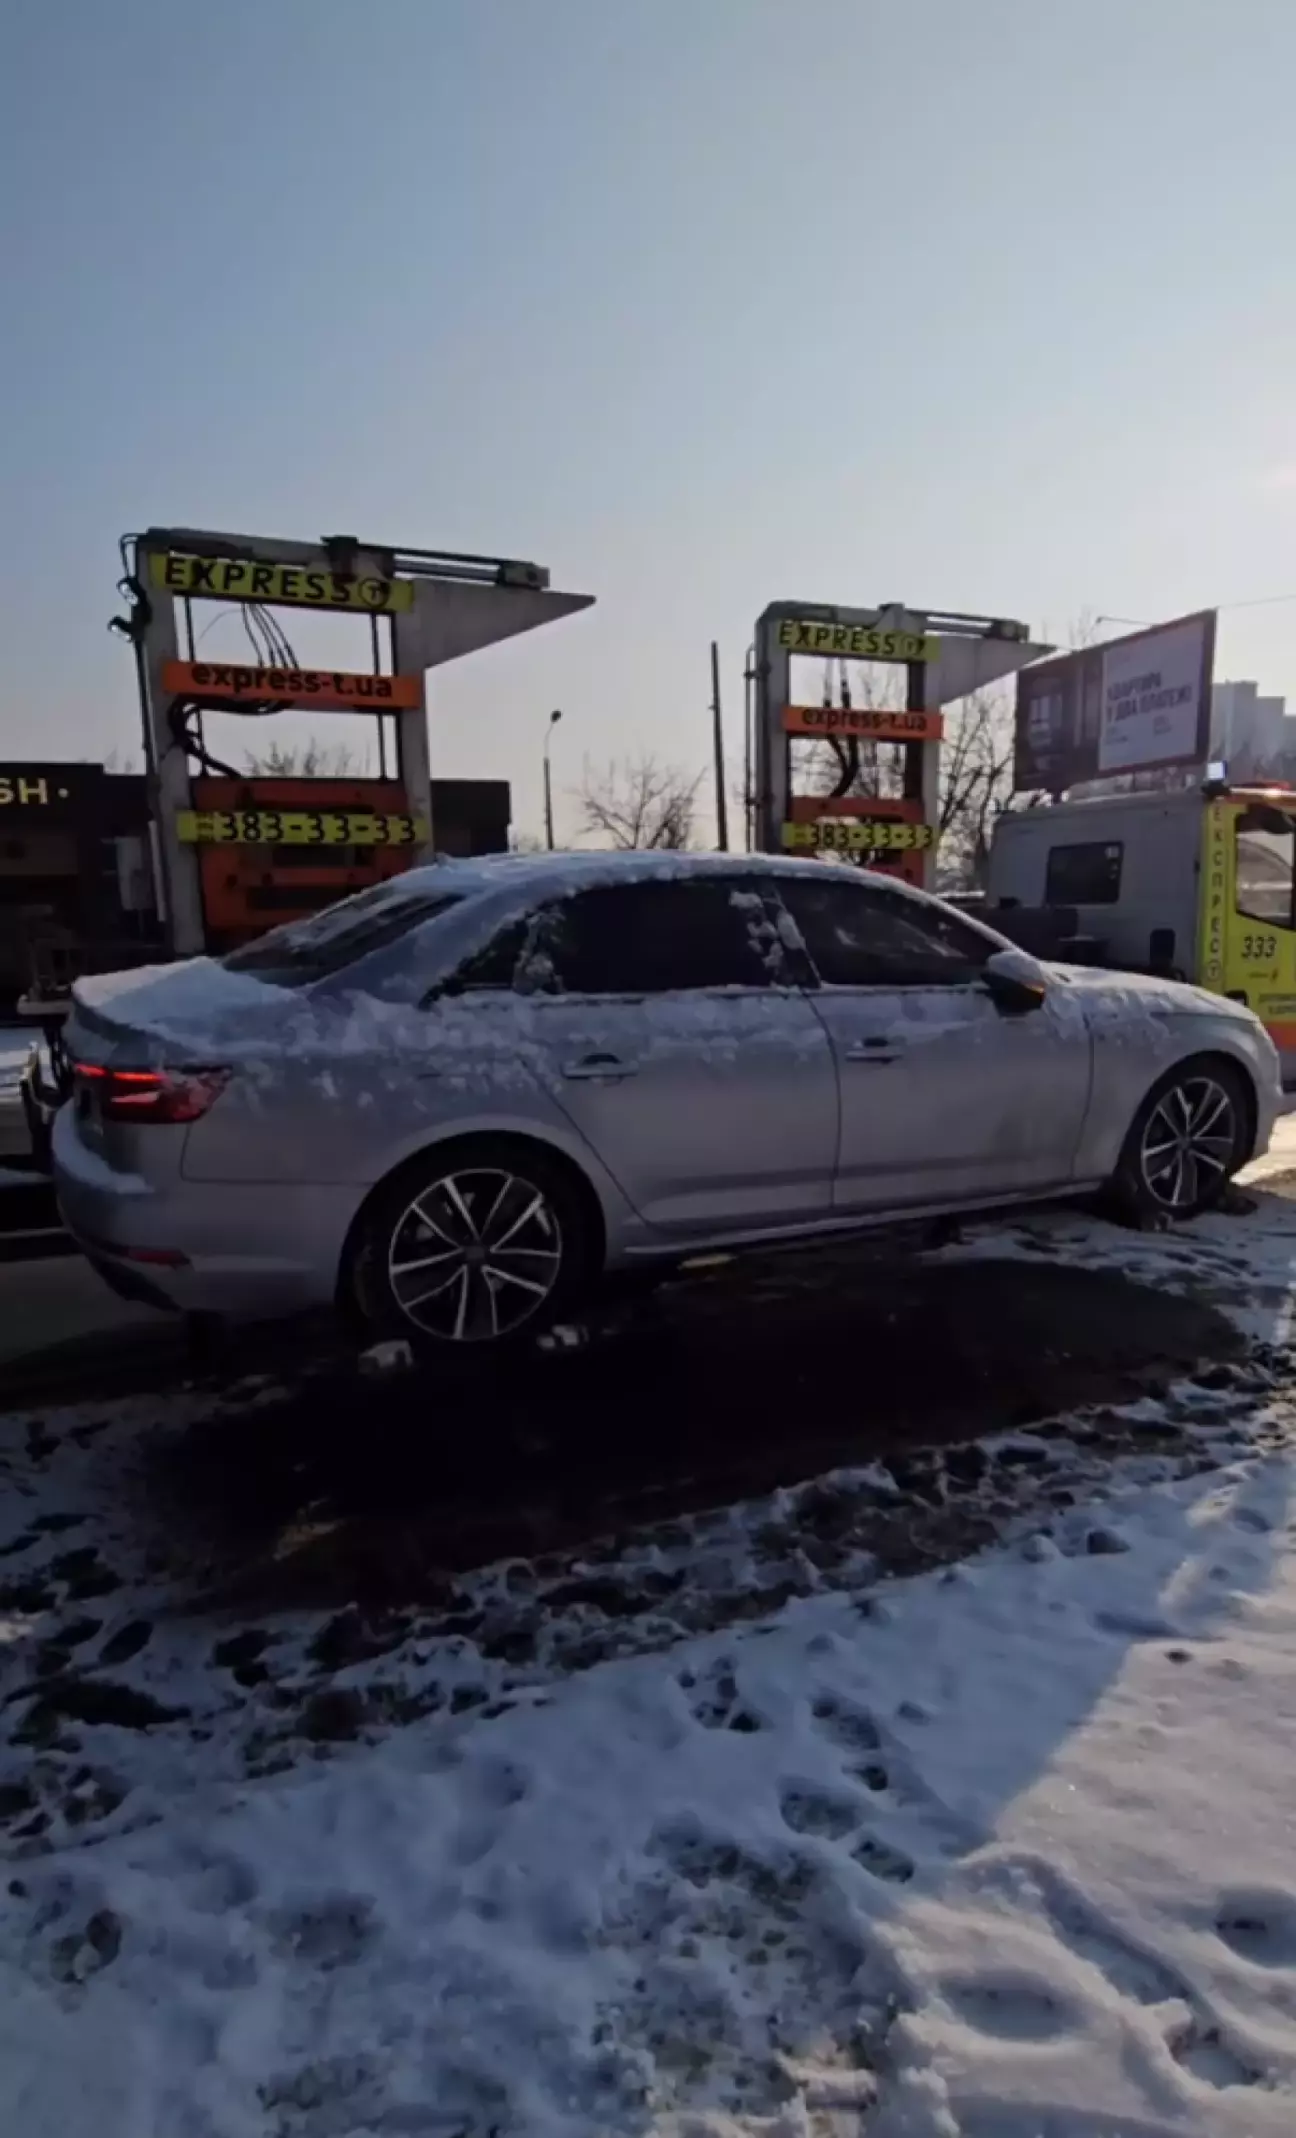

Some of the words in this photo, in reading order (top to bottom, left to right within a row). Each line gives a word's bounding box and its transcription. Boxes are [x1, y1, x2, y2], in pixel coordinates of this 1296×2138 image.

[165, 557, 353, 602] EXPRESS
[780, 620, 895, 655] EXPRESS
[191, 665, 393, 698] express-t.ua
[802, 708, 927, 731] express-t.ua
[219, 811, 416, 842] 383-33-33
[809, 823, 933, 848] 383-33-33
[1241, 936, 1277, 958] 333
